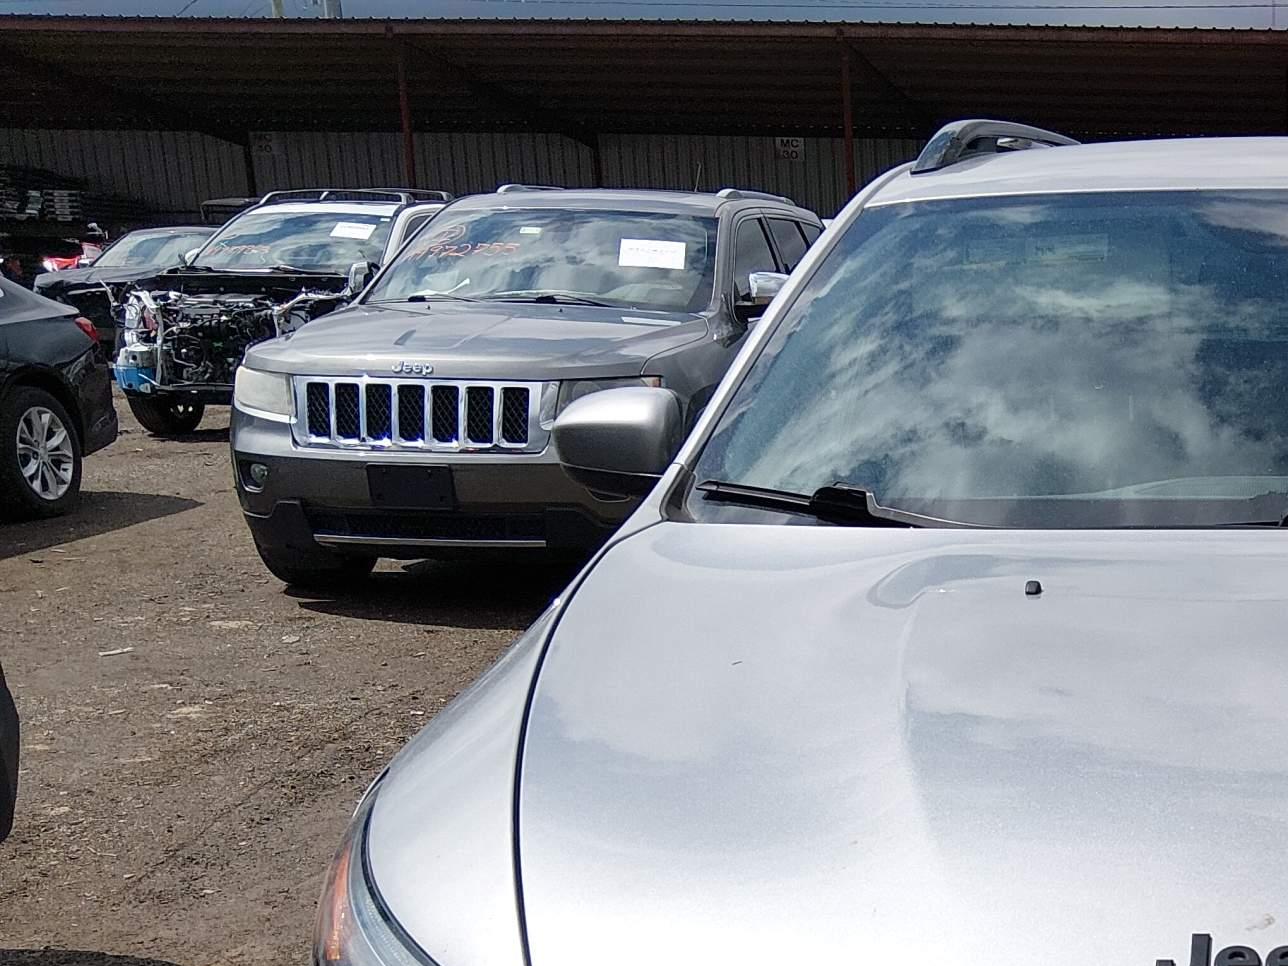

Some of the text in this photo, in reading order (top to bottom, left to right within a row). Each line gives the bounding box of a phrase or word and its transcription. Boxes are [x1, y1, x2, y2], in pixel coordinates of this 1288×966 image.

[781, 139, 799, 148] MC
[783, 150, 798, 160] 30
[391, 360, 434, 376] Jeep
